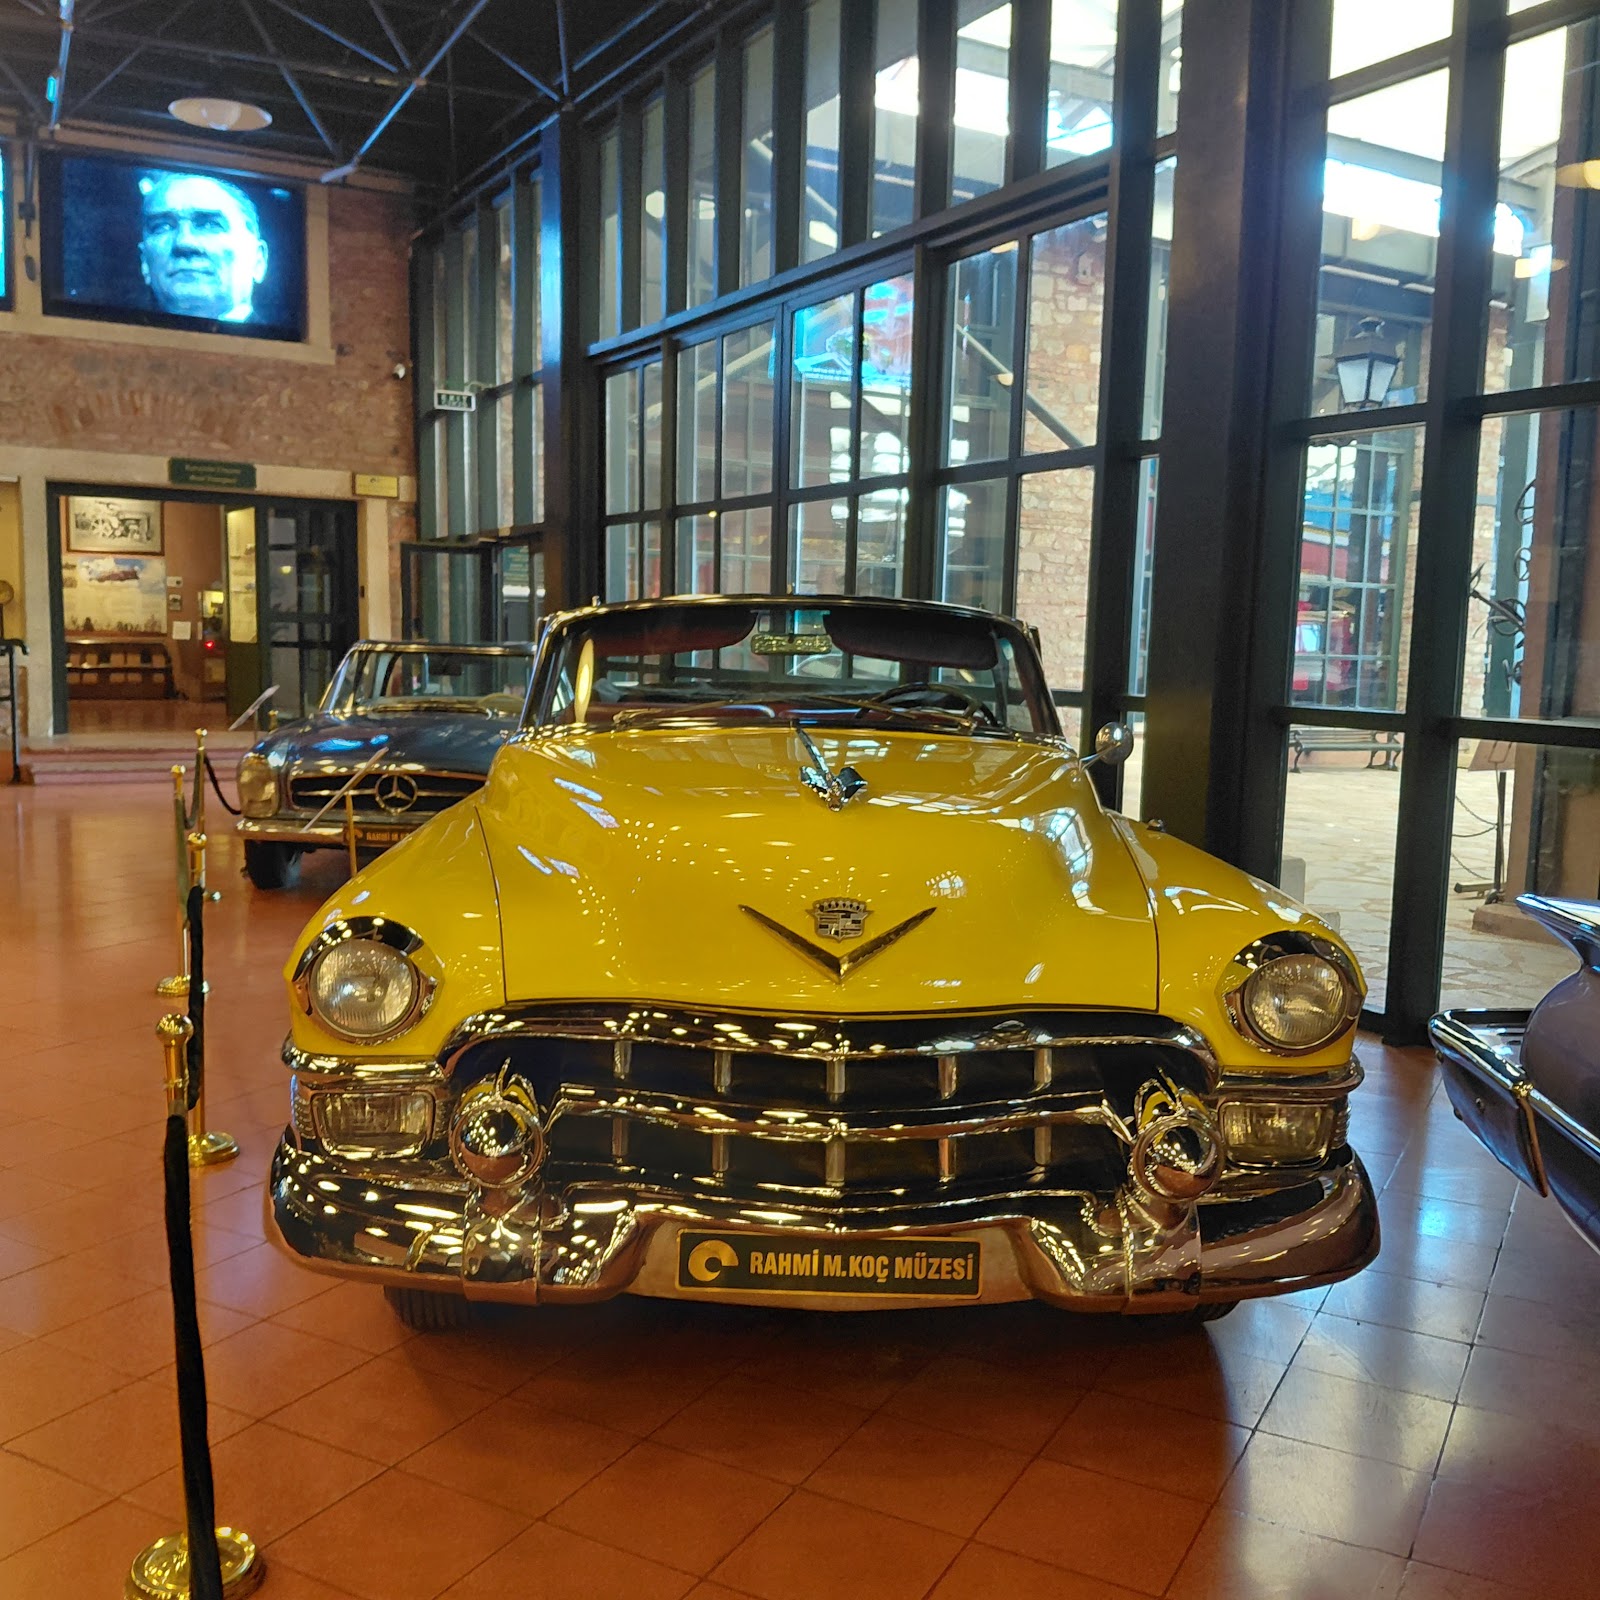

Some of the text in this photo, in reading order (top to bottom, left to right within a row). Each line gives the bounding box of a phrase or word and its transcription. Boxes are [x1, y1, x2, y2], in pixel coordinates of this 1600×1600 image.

[750, 1250, 973, 1283] RAHMİ M. KOÇ MÜZESİ
